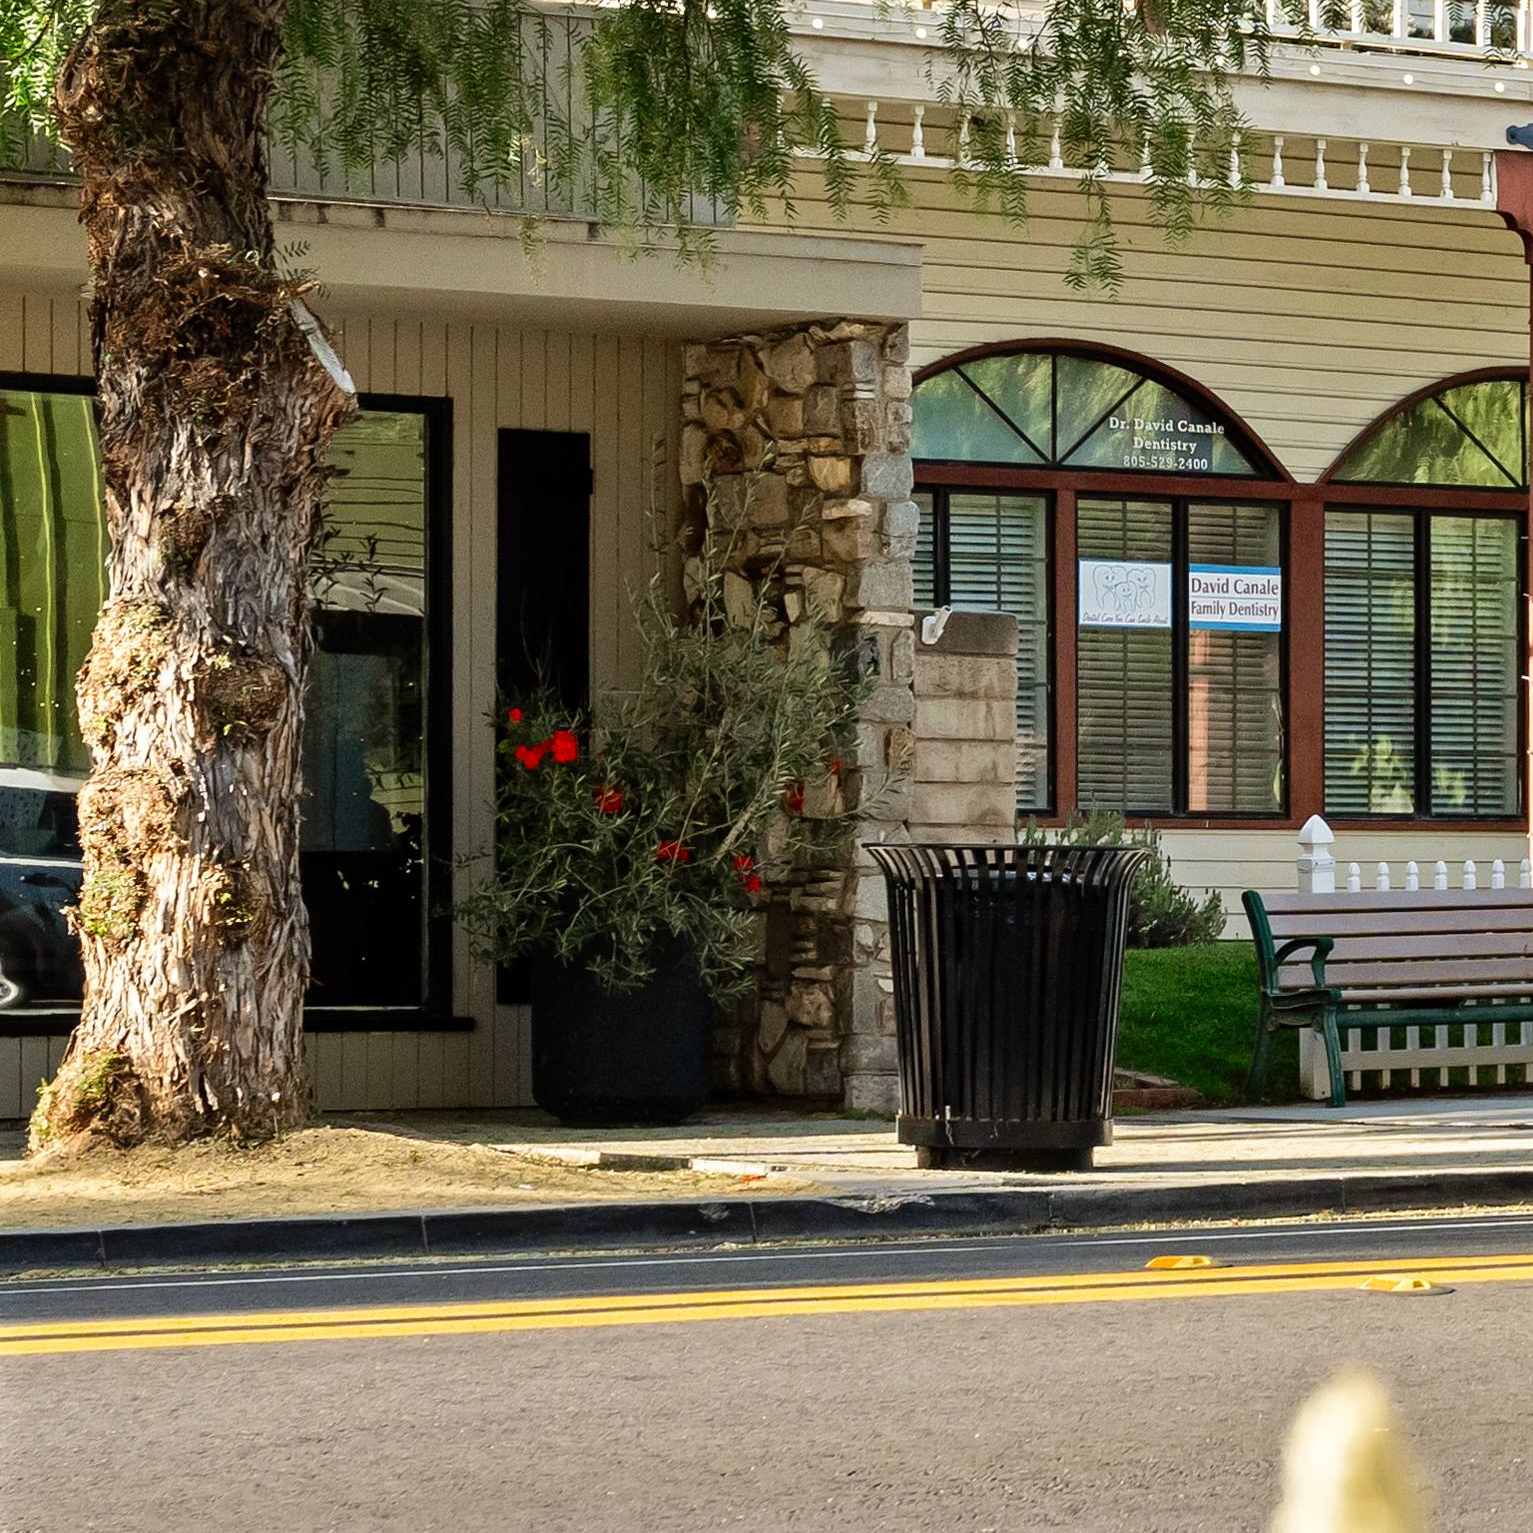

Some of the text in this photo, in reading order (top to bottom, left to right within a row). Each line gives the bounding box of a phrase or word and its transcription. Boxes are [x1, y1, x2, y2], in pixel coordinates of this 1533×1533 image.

[1109, 416, 1225, 435] Dr. David Canale
[1133, 436, 1198, 455] Dentistry
[1123, 455, 1208, 470] 805-529-2400
[1191, 577, 1279, 595] David Canale
[1191, 600, 1279, 622] Family Dentistry
